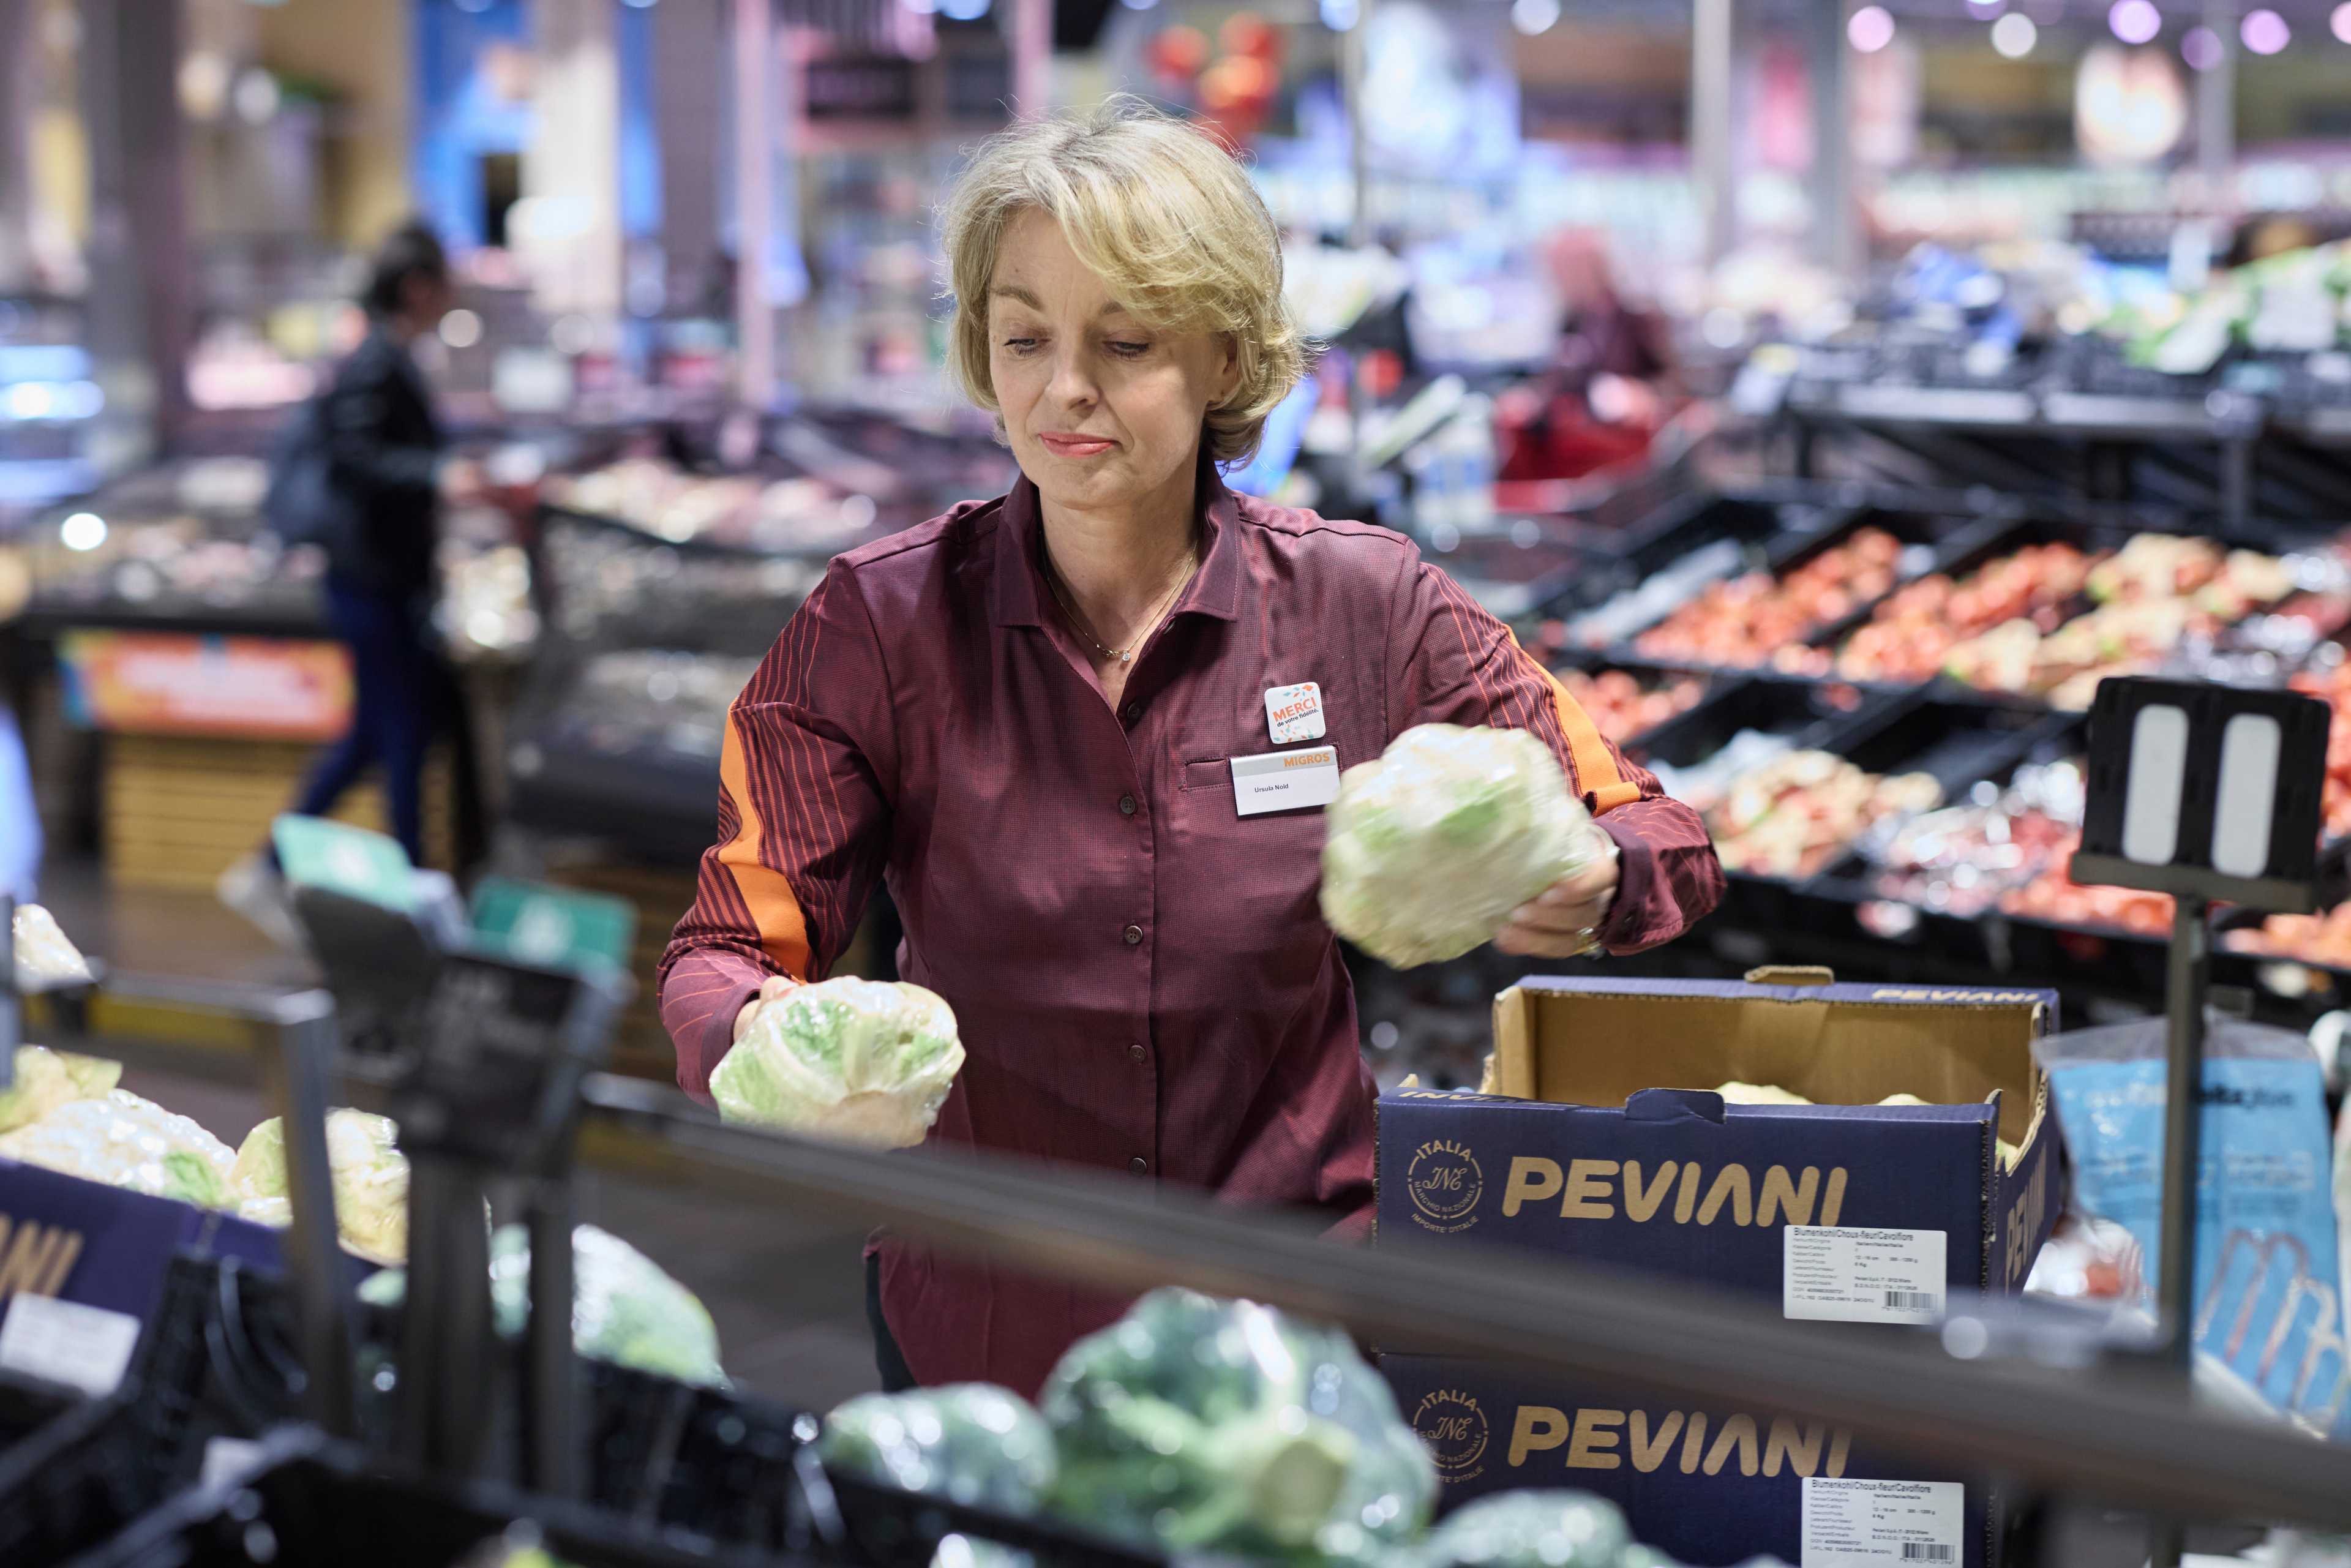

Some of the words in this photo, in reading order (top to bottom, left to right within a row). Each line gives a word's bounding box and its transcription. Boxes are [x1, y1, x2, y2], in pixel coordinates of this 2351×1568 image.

[1273, 697, 1317, 722] MERCI
[1283, 752, 1330, 767] MIGROS
[1872, 989, 2038, 1002] PEVIANI
[1415, 1139, 1472, 1162] ITALIA
[1441, 1184, 1477, 1212] NAZIONALE
[1502, 1155, 1848, 1228] PEVIANI
[1421, 1389, 1477, 1411] ITALIA
[1508, 1405, 1853, 1478] PEVIANI
